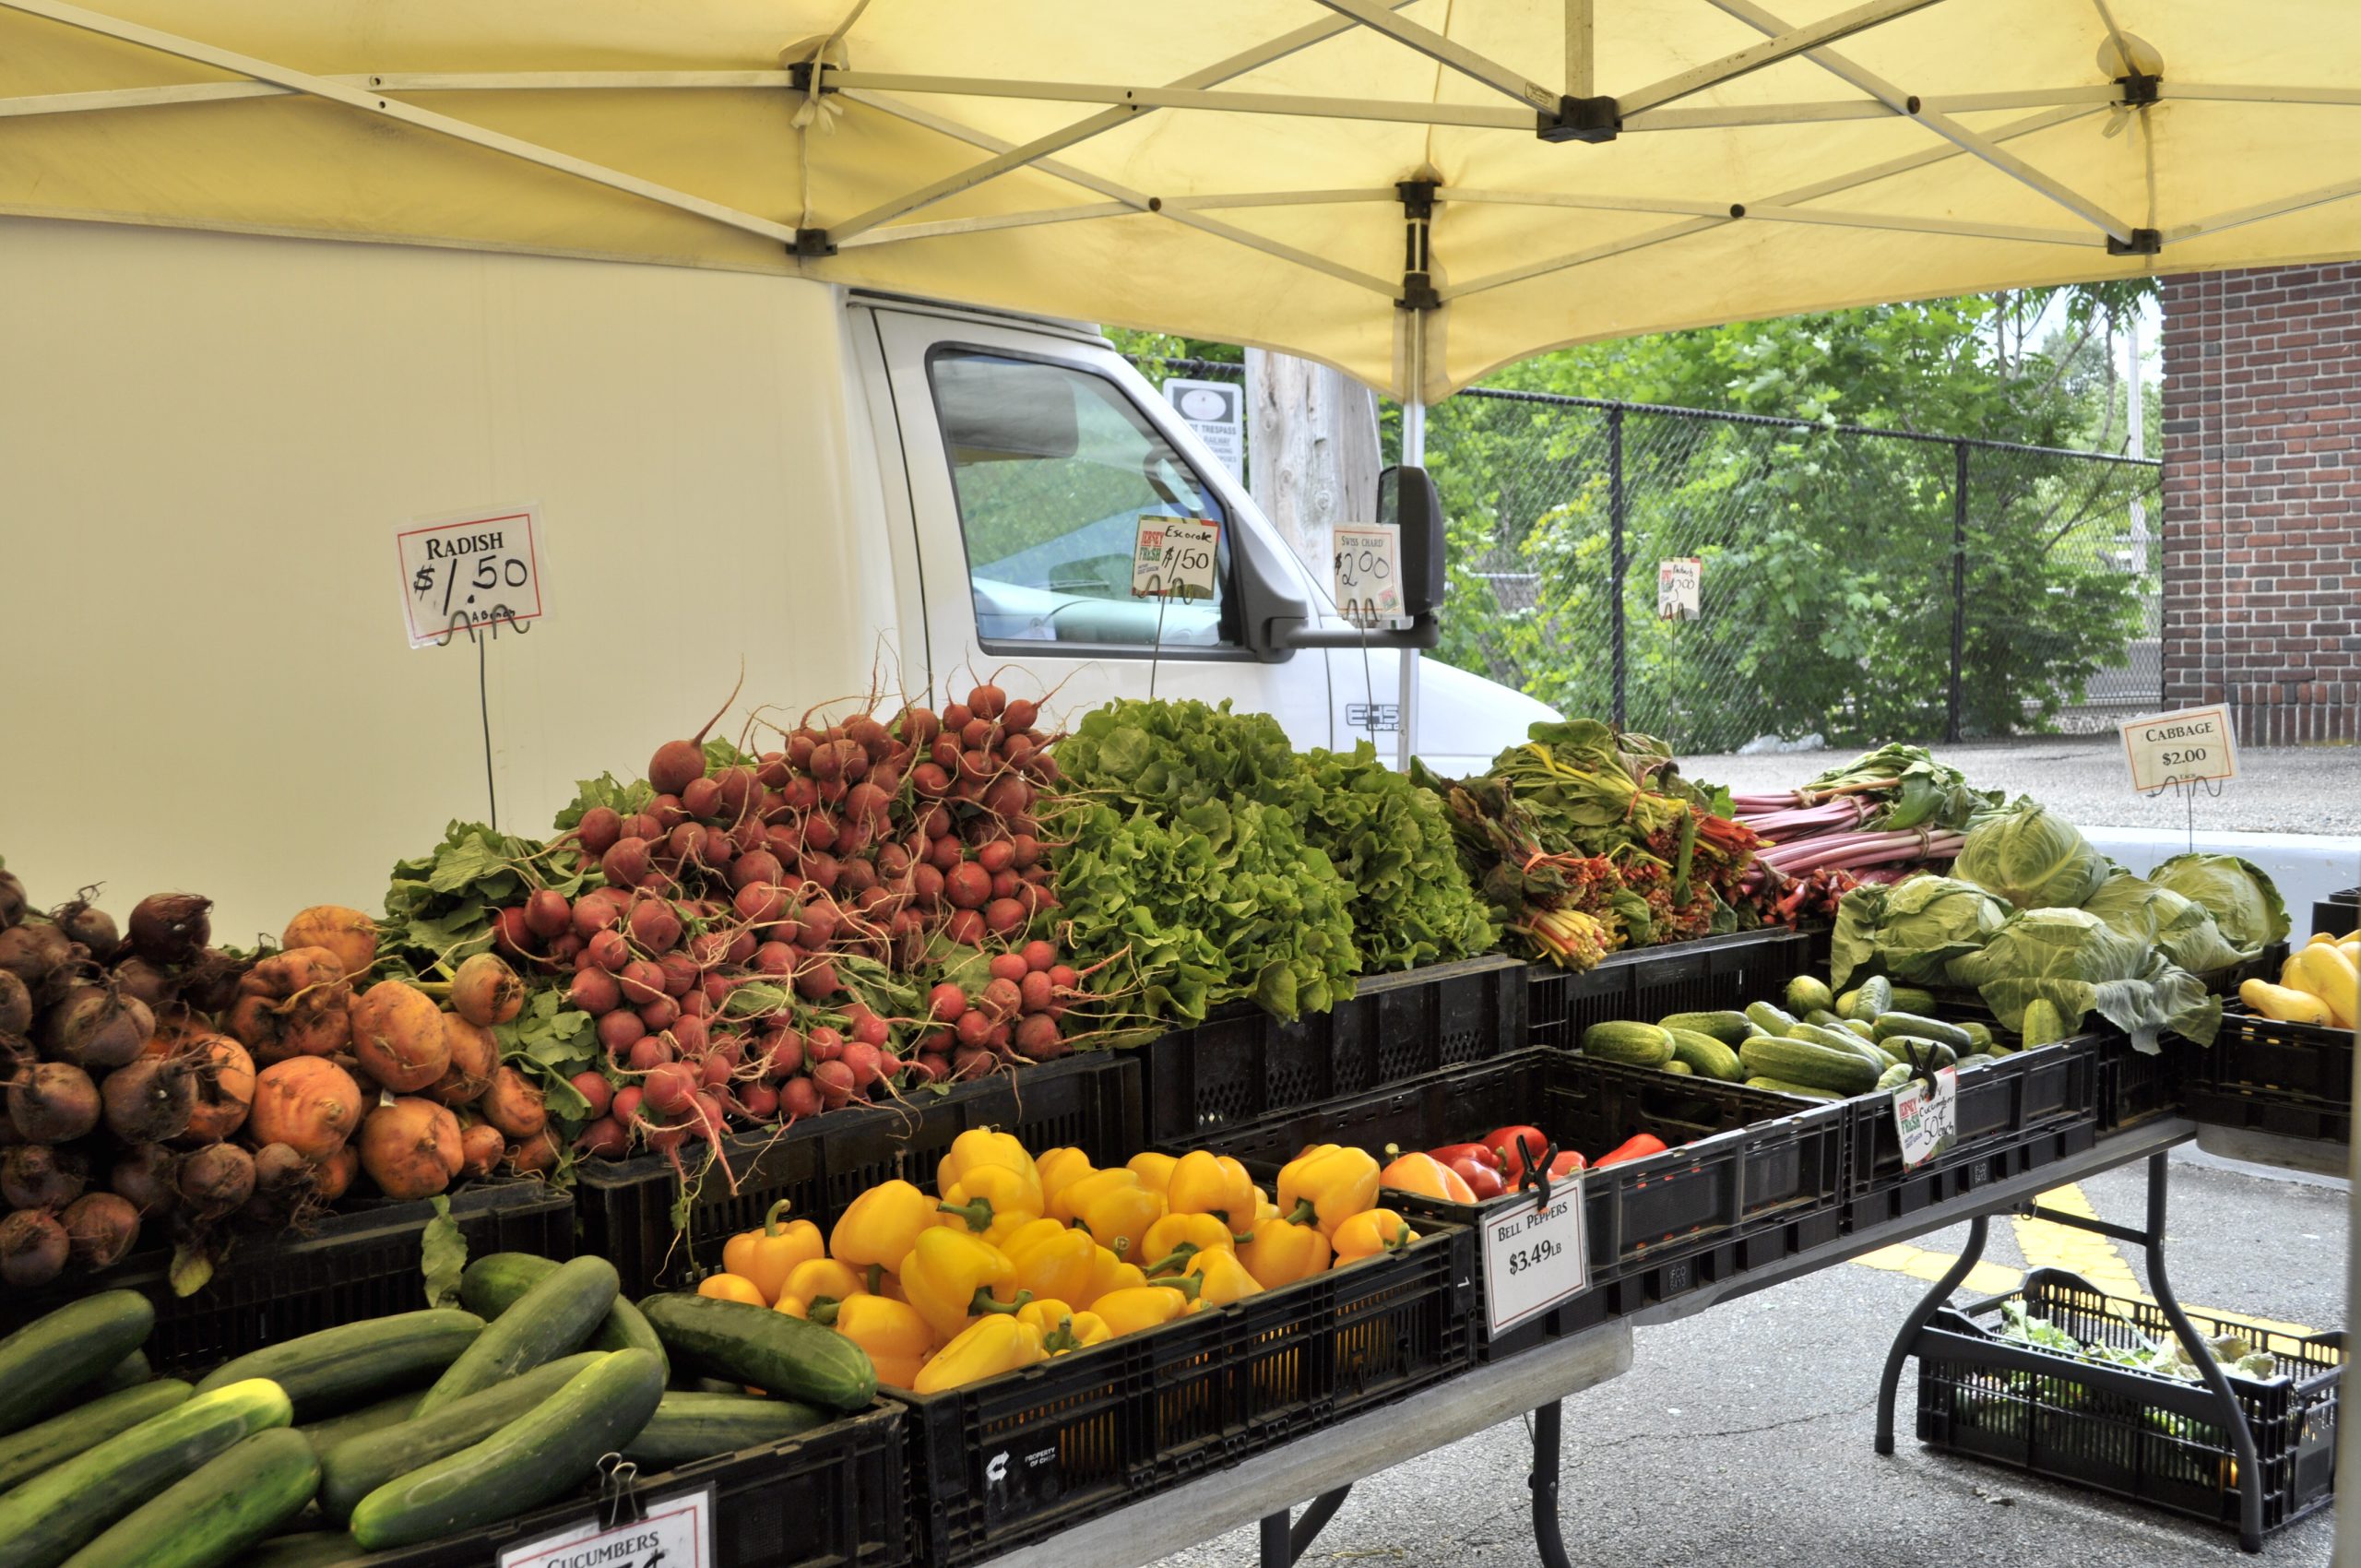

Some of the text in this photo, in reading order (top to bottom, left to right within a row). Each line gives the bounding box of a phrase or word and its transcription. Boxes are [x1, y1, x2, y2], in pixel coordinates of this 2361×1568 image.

[1202, 424, 1237, 435] TRESPASS
[1138, 547, 1161, 561] FRESH
[2145, 722, 2213, 742] CABBAGE
[2162, 748, 2206, 766] $2.00
[1498, 1222, 1522, 1242] BELL
[1025, 1446, 1056, 1463] PROPERTY
